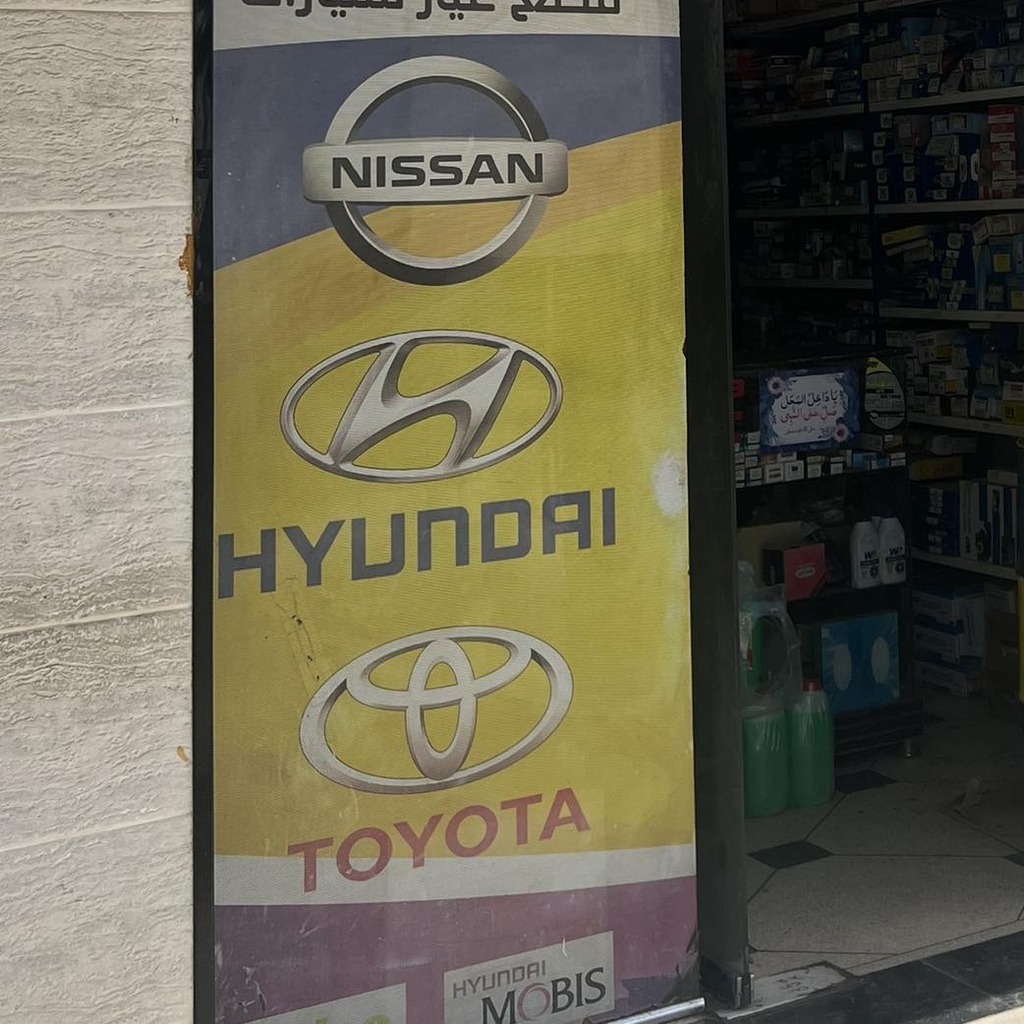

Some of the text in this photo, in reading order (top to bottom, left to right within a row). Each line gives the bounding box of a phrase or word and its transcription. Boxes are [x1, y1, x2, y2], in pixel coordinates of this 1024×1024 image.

[332, 152, 544, 189] NISSAN
[217, 487, 617, 600] HYUNDAI
[288, 788, 591, 894] TOYOTA
[452, 960, 546, 999] HYUNDAI
[481, 966, 607, 1024] MOBIS
